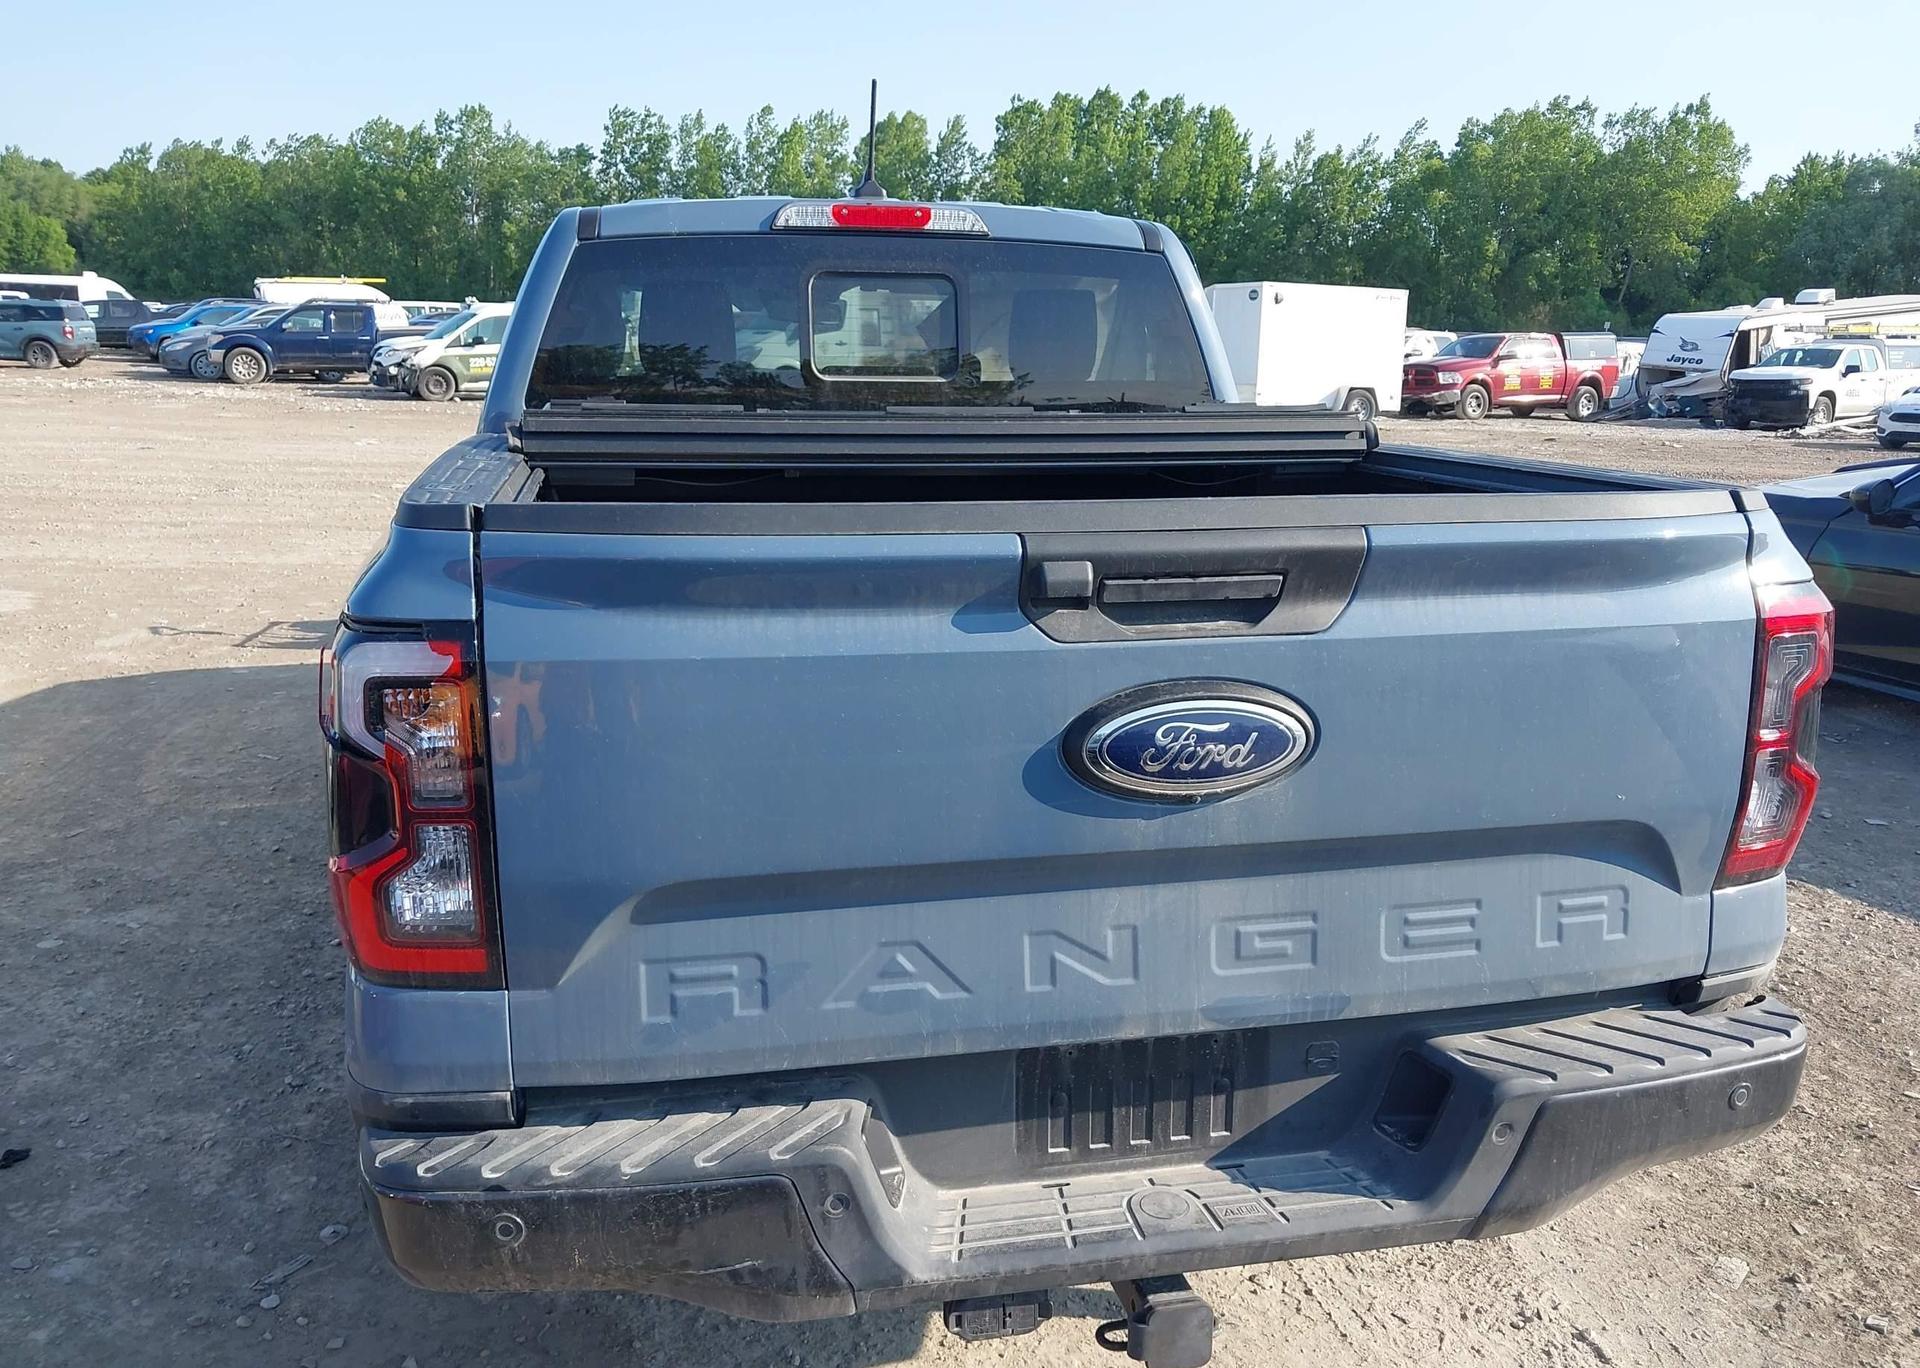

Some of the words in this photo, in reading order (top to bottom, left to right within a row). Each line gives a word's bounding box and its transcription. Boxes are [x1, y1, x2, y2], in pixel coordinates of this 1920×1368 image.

[1666, 354, 1704, 365] Jayco
[1140, 721, 1258, 772] Ford
[641, 884, 1630, 1024] RANGER
